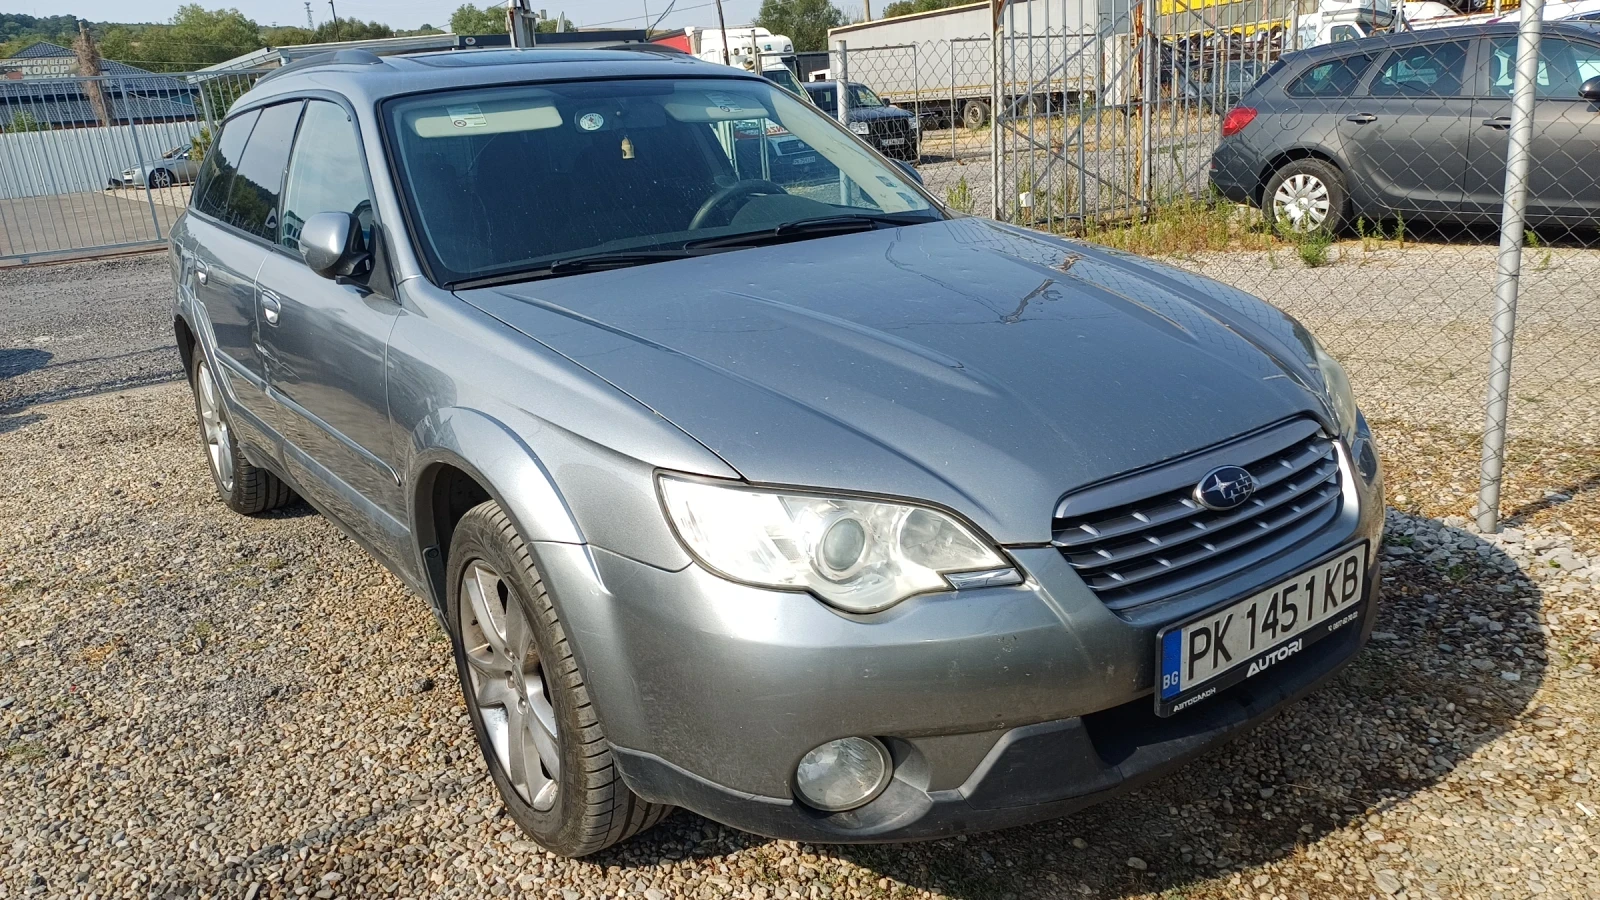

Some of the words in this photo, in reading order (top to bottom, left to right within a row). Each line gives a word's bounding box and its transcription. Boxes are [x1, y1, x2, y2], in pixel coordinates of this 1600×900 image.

[22, 65, 69, 75] КОЛОР
[1187, 613, 1233, 681] PK
[1246, 575, 1316, 650] 1451
[1322, 555, 1358, 614] KB
[1246, 638, 1303, 678] AUTORI
[1162, 670, 1179, 690] BG
